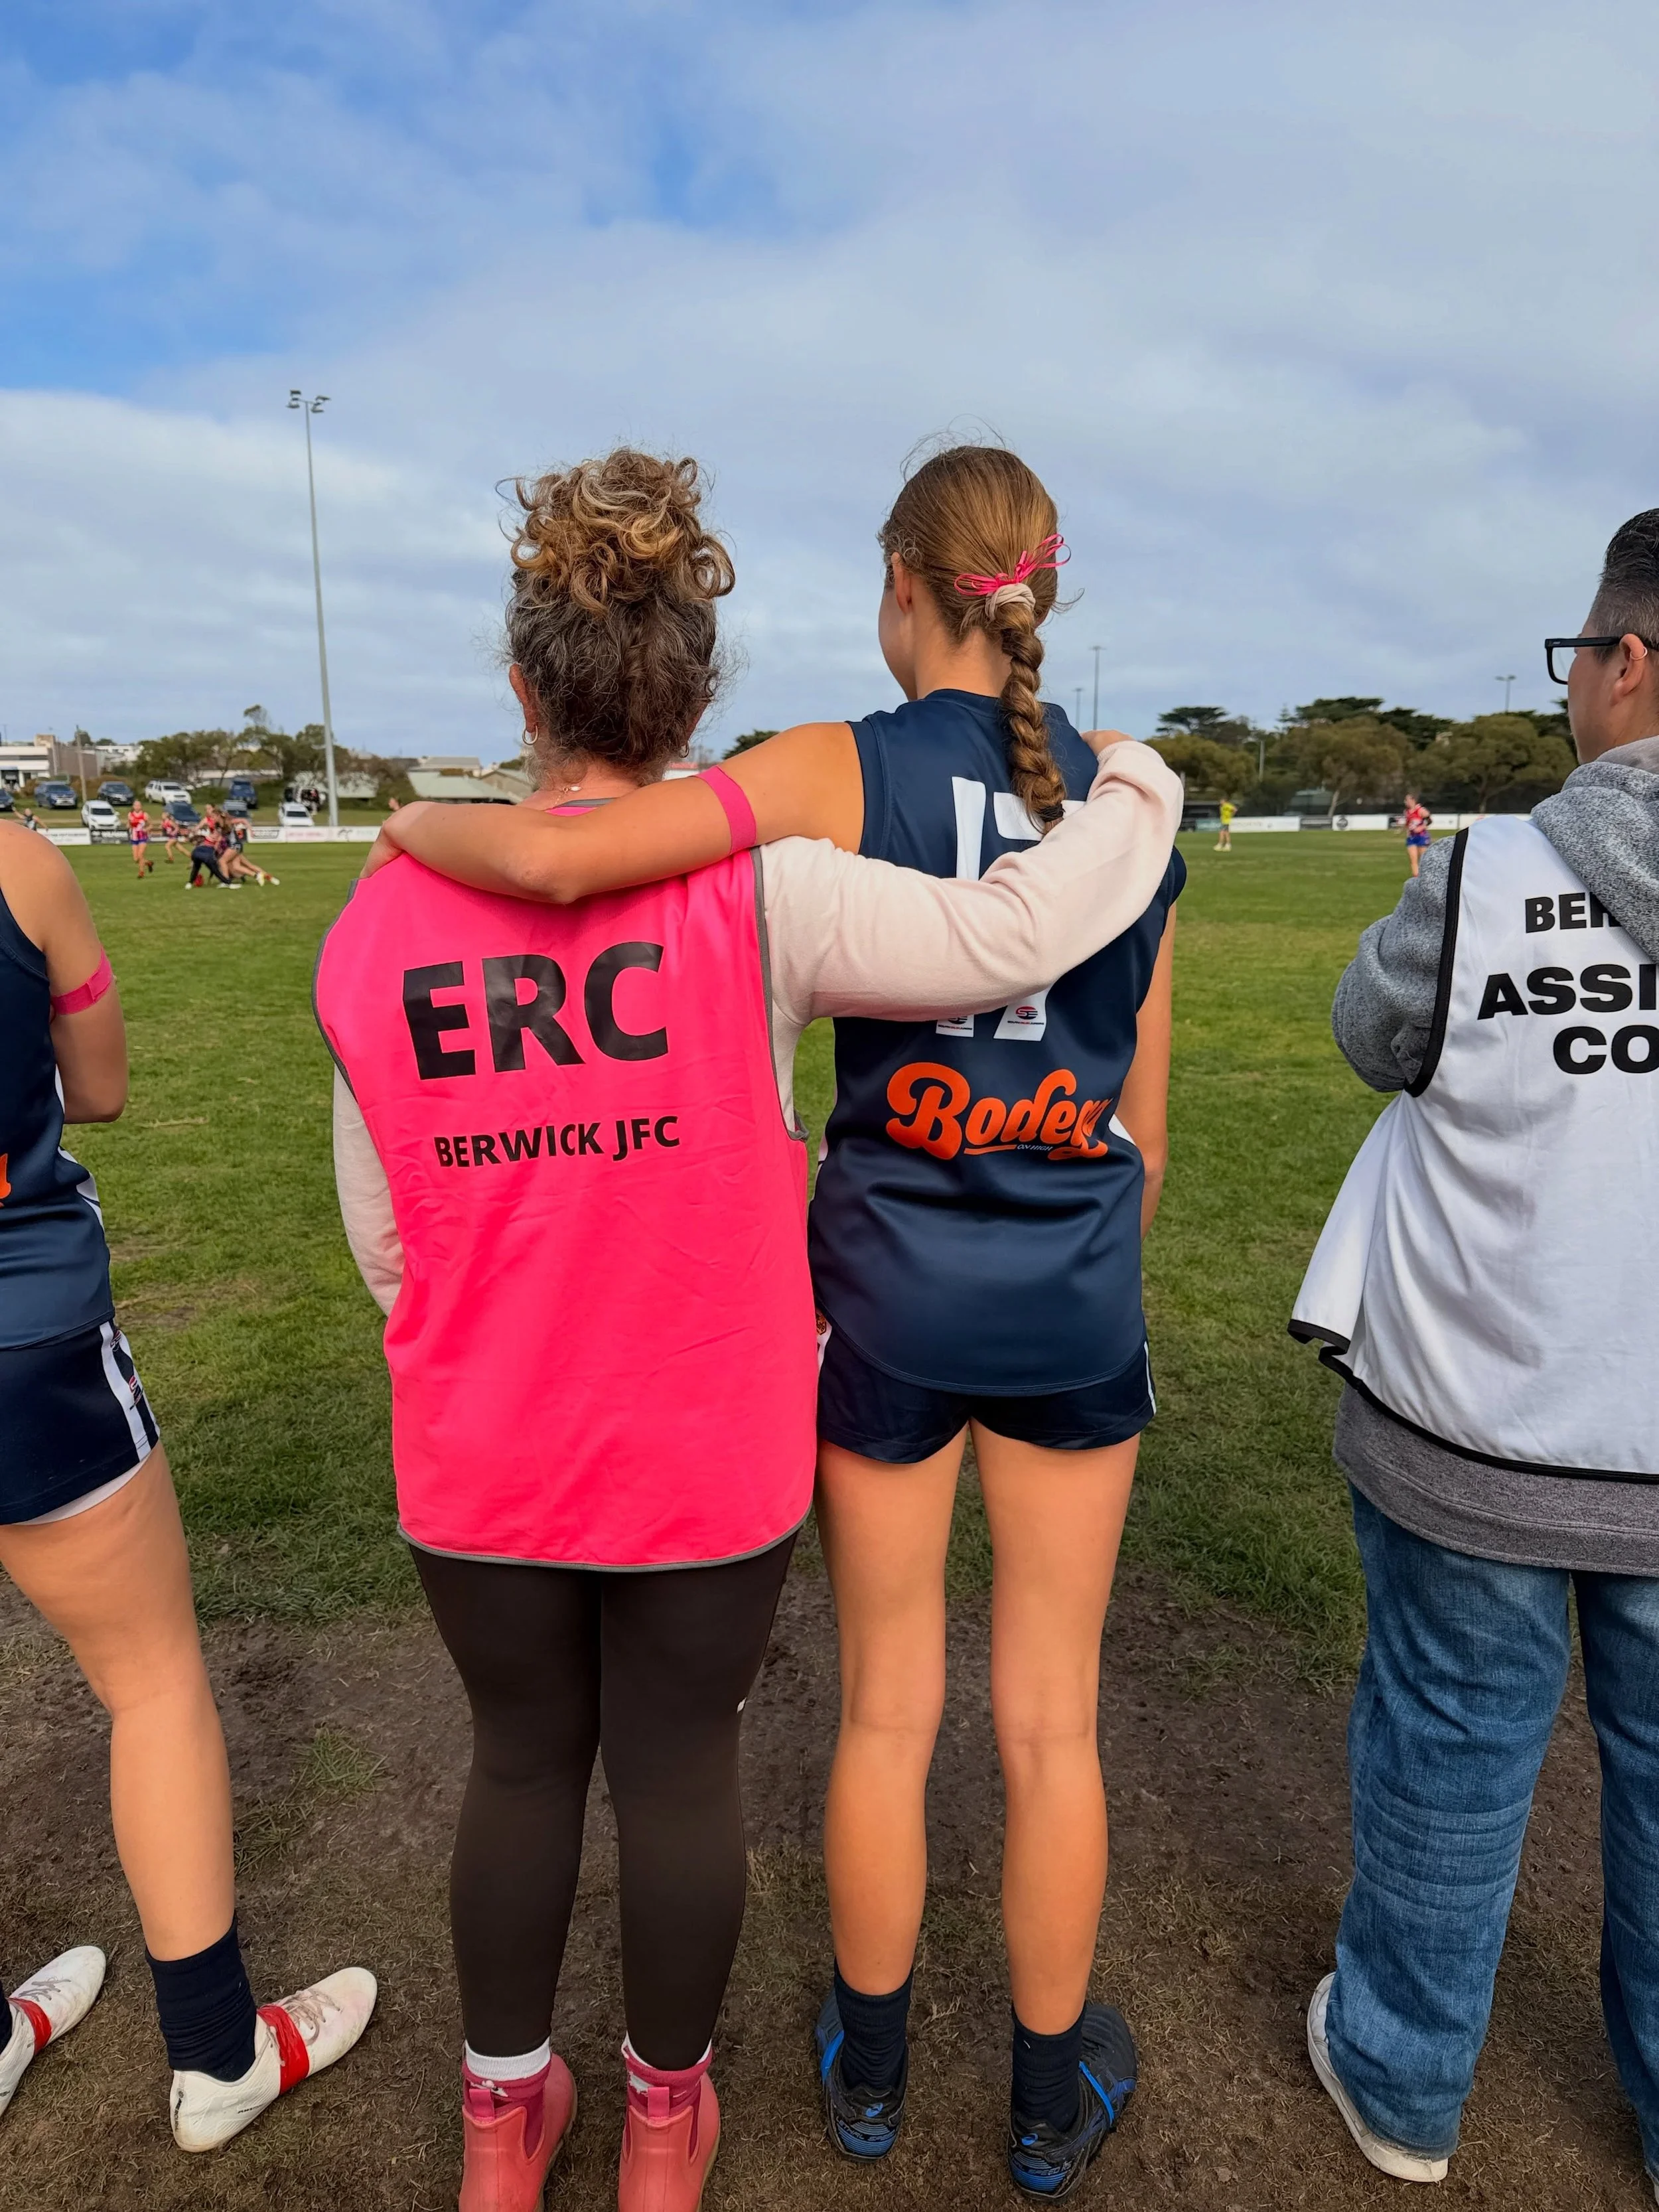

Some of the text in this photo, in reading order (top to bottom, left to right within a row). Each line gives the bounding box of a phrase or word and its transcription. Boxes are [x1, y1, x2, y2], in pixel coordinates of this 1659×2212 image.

[402, 941, 669, 1080] ERC
[1477, 963, 1657, 1021] ASSI
[1553, 1024, 1659, 1074] CO
[434, 1115, 681, 1168] BERWICK JFC
